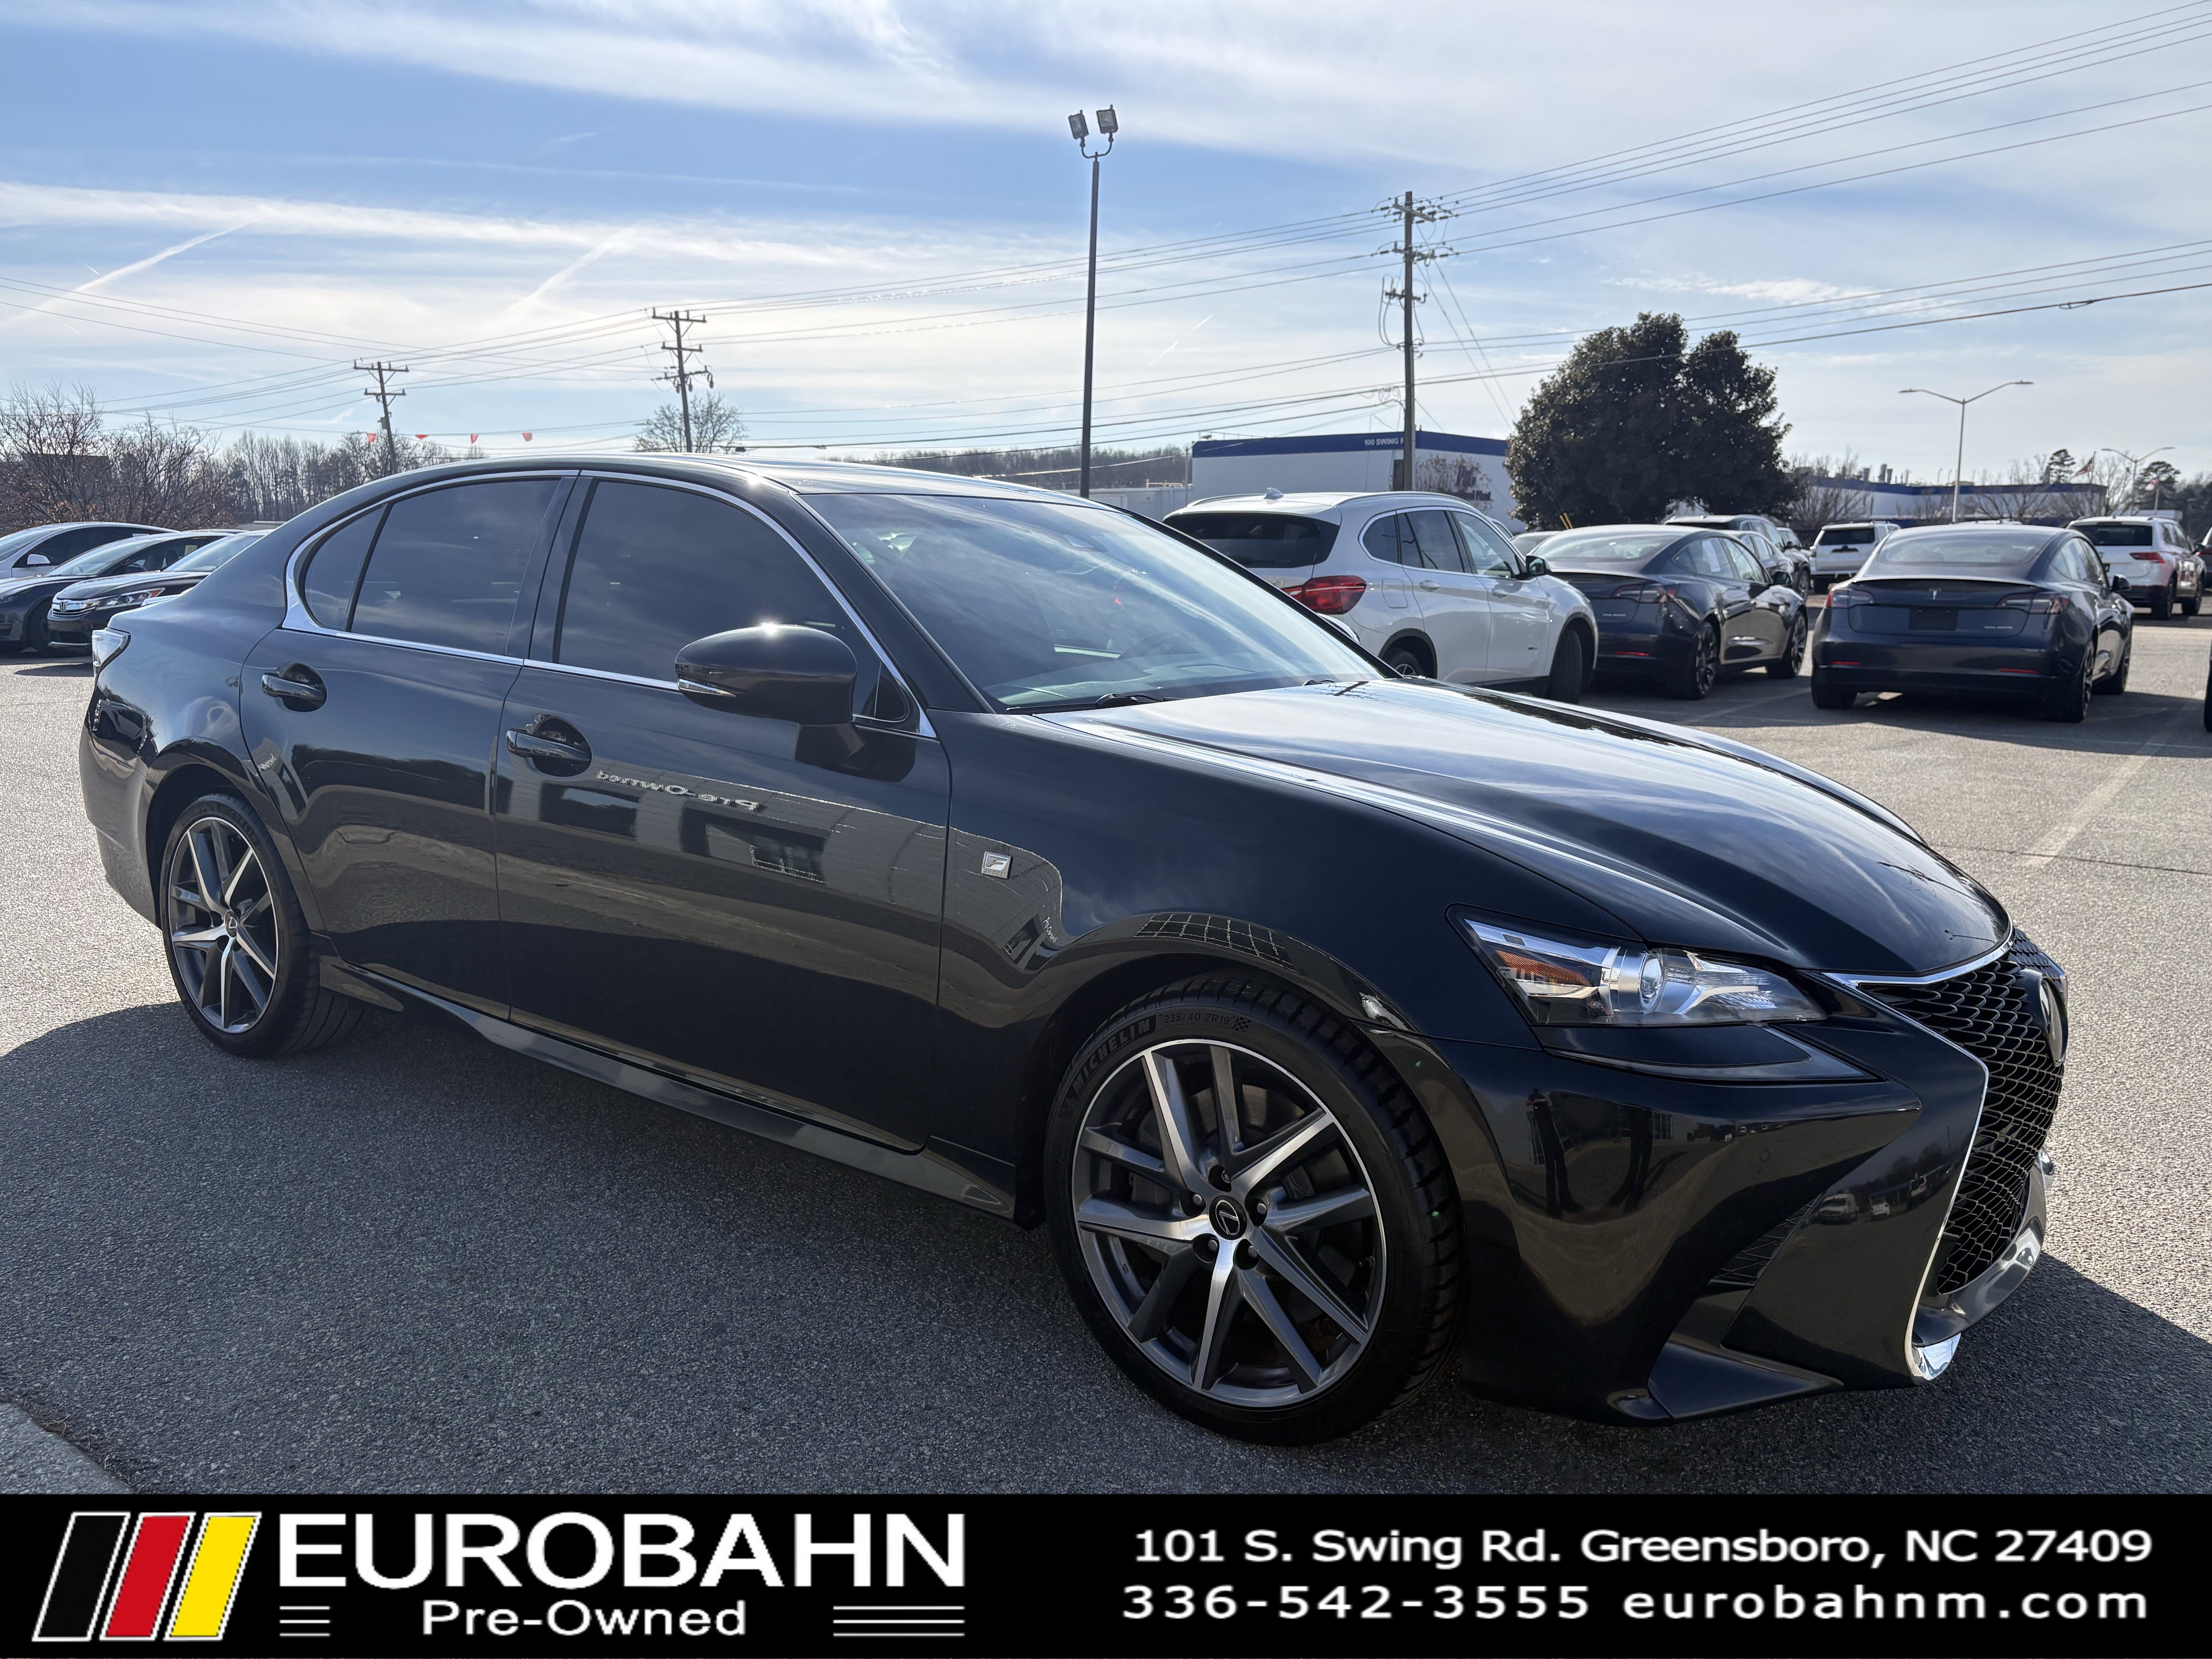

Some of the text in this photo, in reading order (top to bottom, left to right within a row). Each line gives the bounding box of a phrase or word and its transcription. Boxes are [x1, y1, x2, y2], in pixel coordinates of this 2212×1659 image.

[1164, 1013, 1230, 1024] 235/40 ZR19
[1072, 1018, 1150, 1094] MICHELIN
